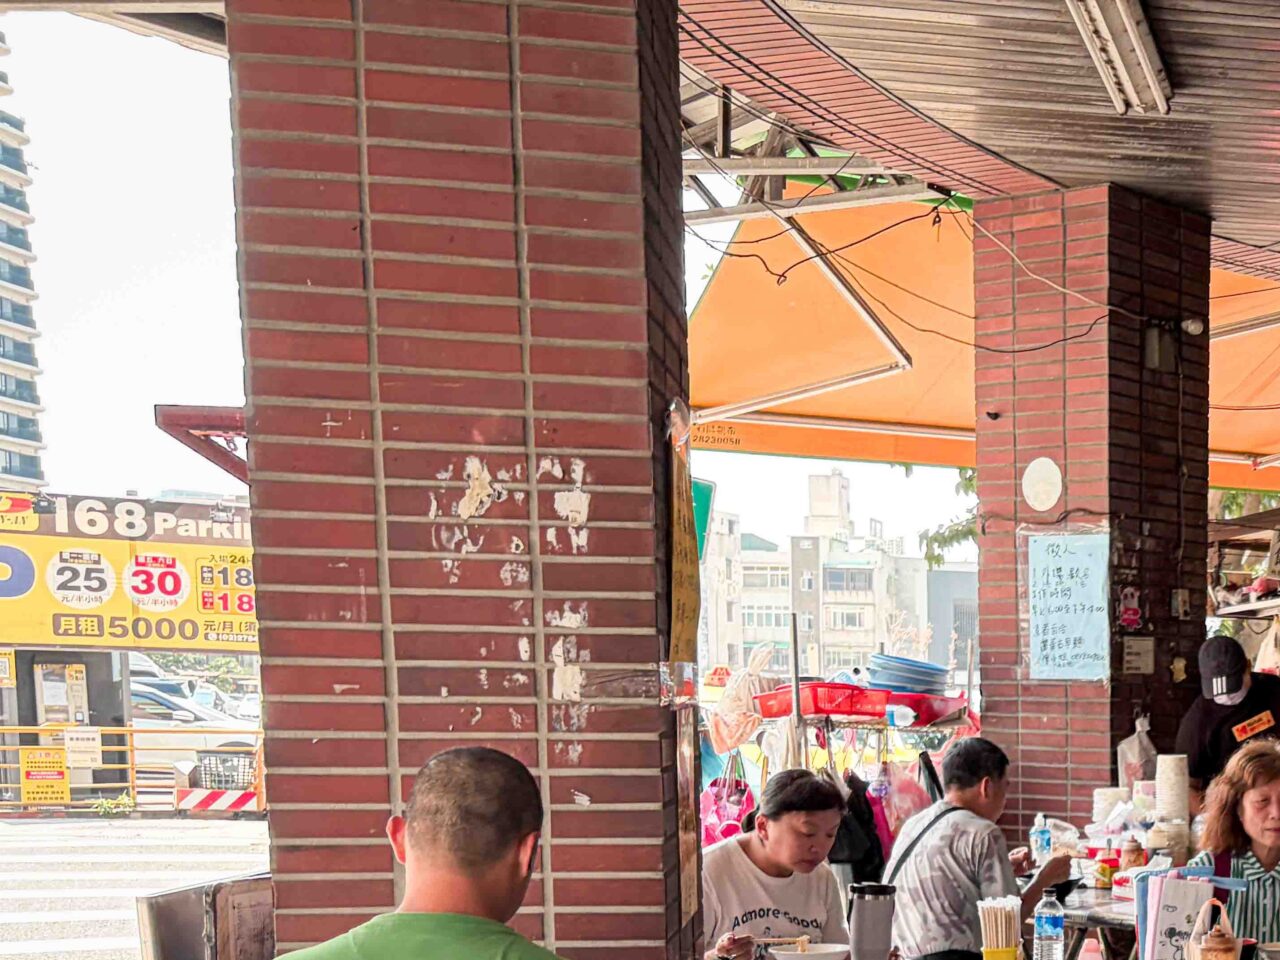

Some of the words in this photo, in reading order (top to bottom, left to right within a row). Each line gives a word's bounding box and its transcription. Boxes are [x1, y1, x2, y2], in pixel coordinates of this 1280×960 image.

[55, 497, 147, 537] 168
[56, 566, 107, 592] 25
[131, 569, 182, 596] 30
[58, 616, 99, 636] 月租
[109, 616, 200, 641] 5000
